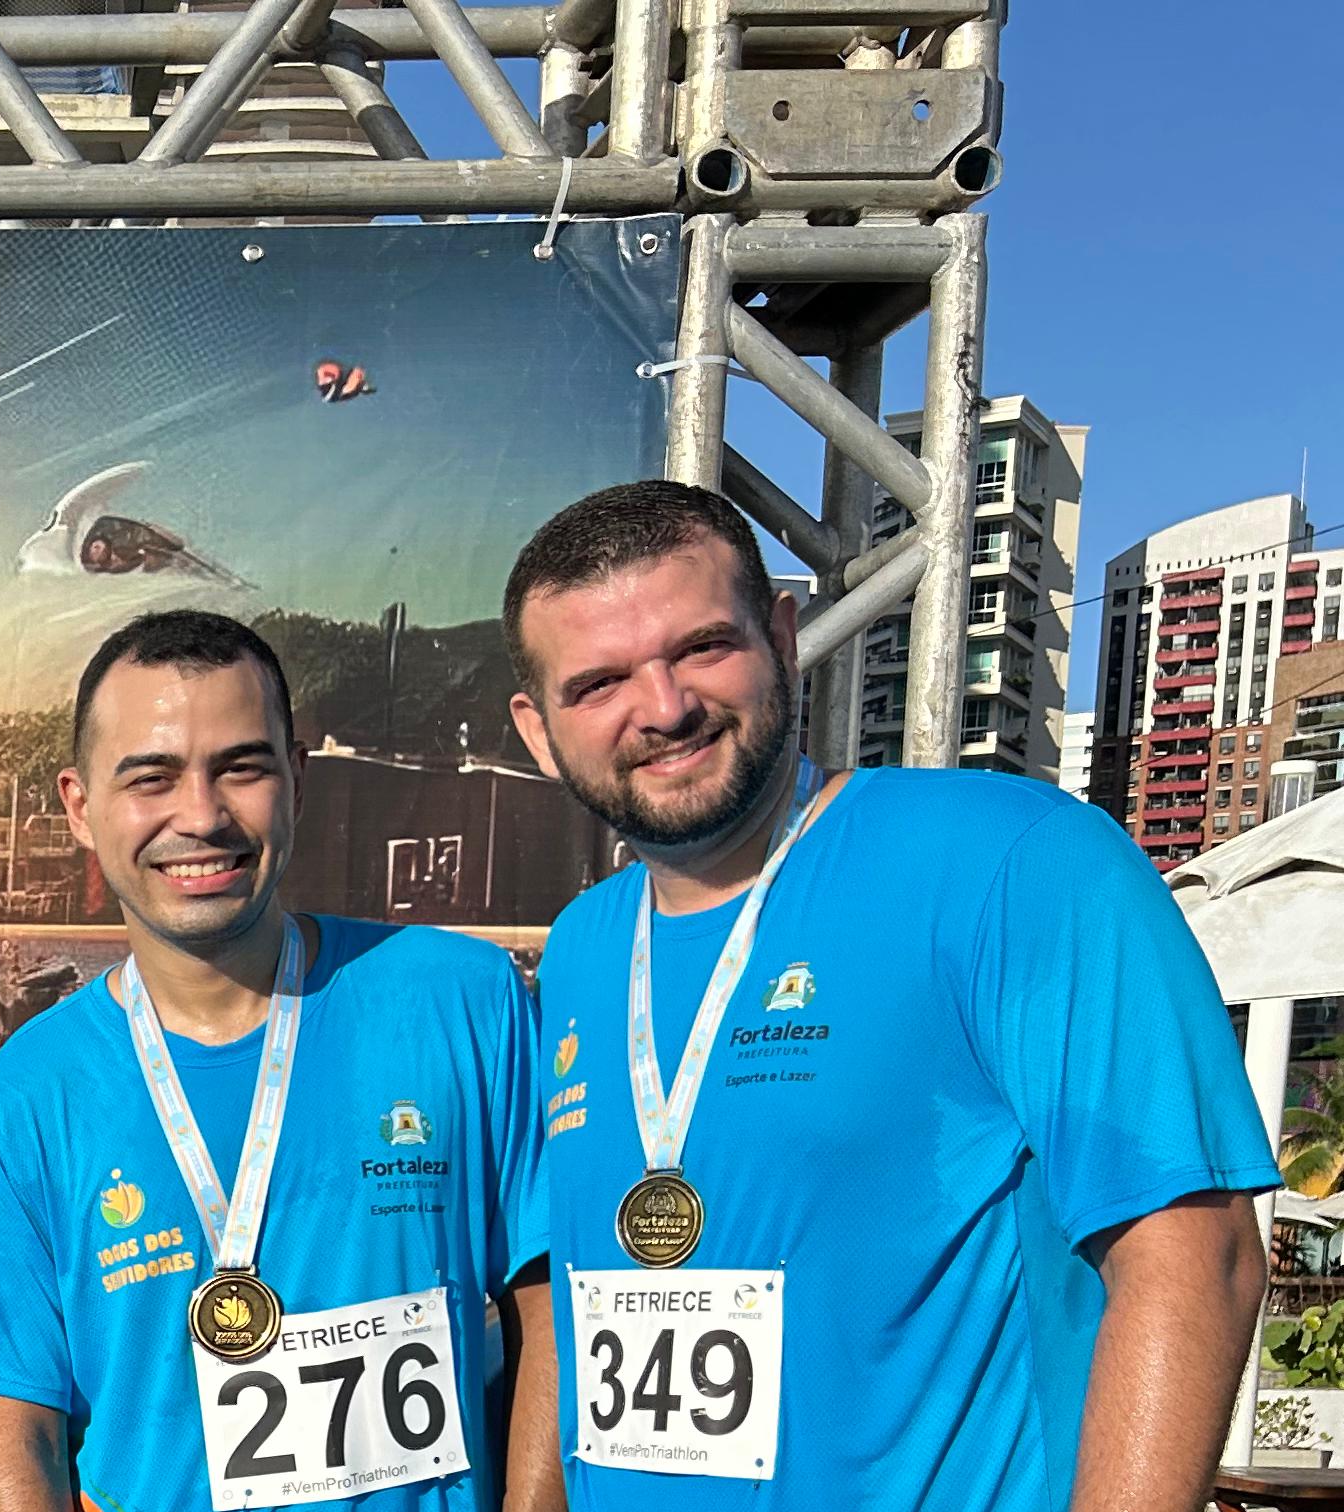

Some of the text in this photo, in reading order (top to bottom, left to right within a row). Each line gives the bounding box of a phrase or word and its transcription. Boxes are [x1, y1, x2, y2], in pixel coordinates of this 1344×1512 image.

[730, 1020, 829, 1047] Fortaleza
[737, 1047, 809, 1060] PREFEITURA
[725, 1070, 816, 1088] Esporte e Lazer
[370, 1203, 416, 1216] Esporte
[144, 1227, 184, 1253] DOS
[613, 1291, 712, 1313] FETRIECE
[282, 1316, 387, 1351] ETRIECE
[589, 1329, 754, 1436] 349
[217, 1342, 446, 1480] 276
[609, 1444, 708, 1461] #VemProTriathlon
[281, 1464, 409, 1495] #VemProTriathlon
